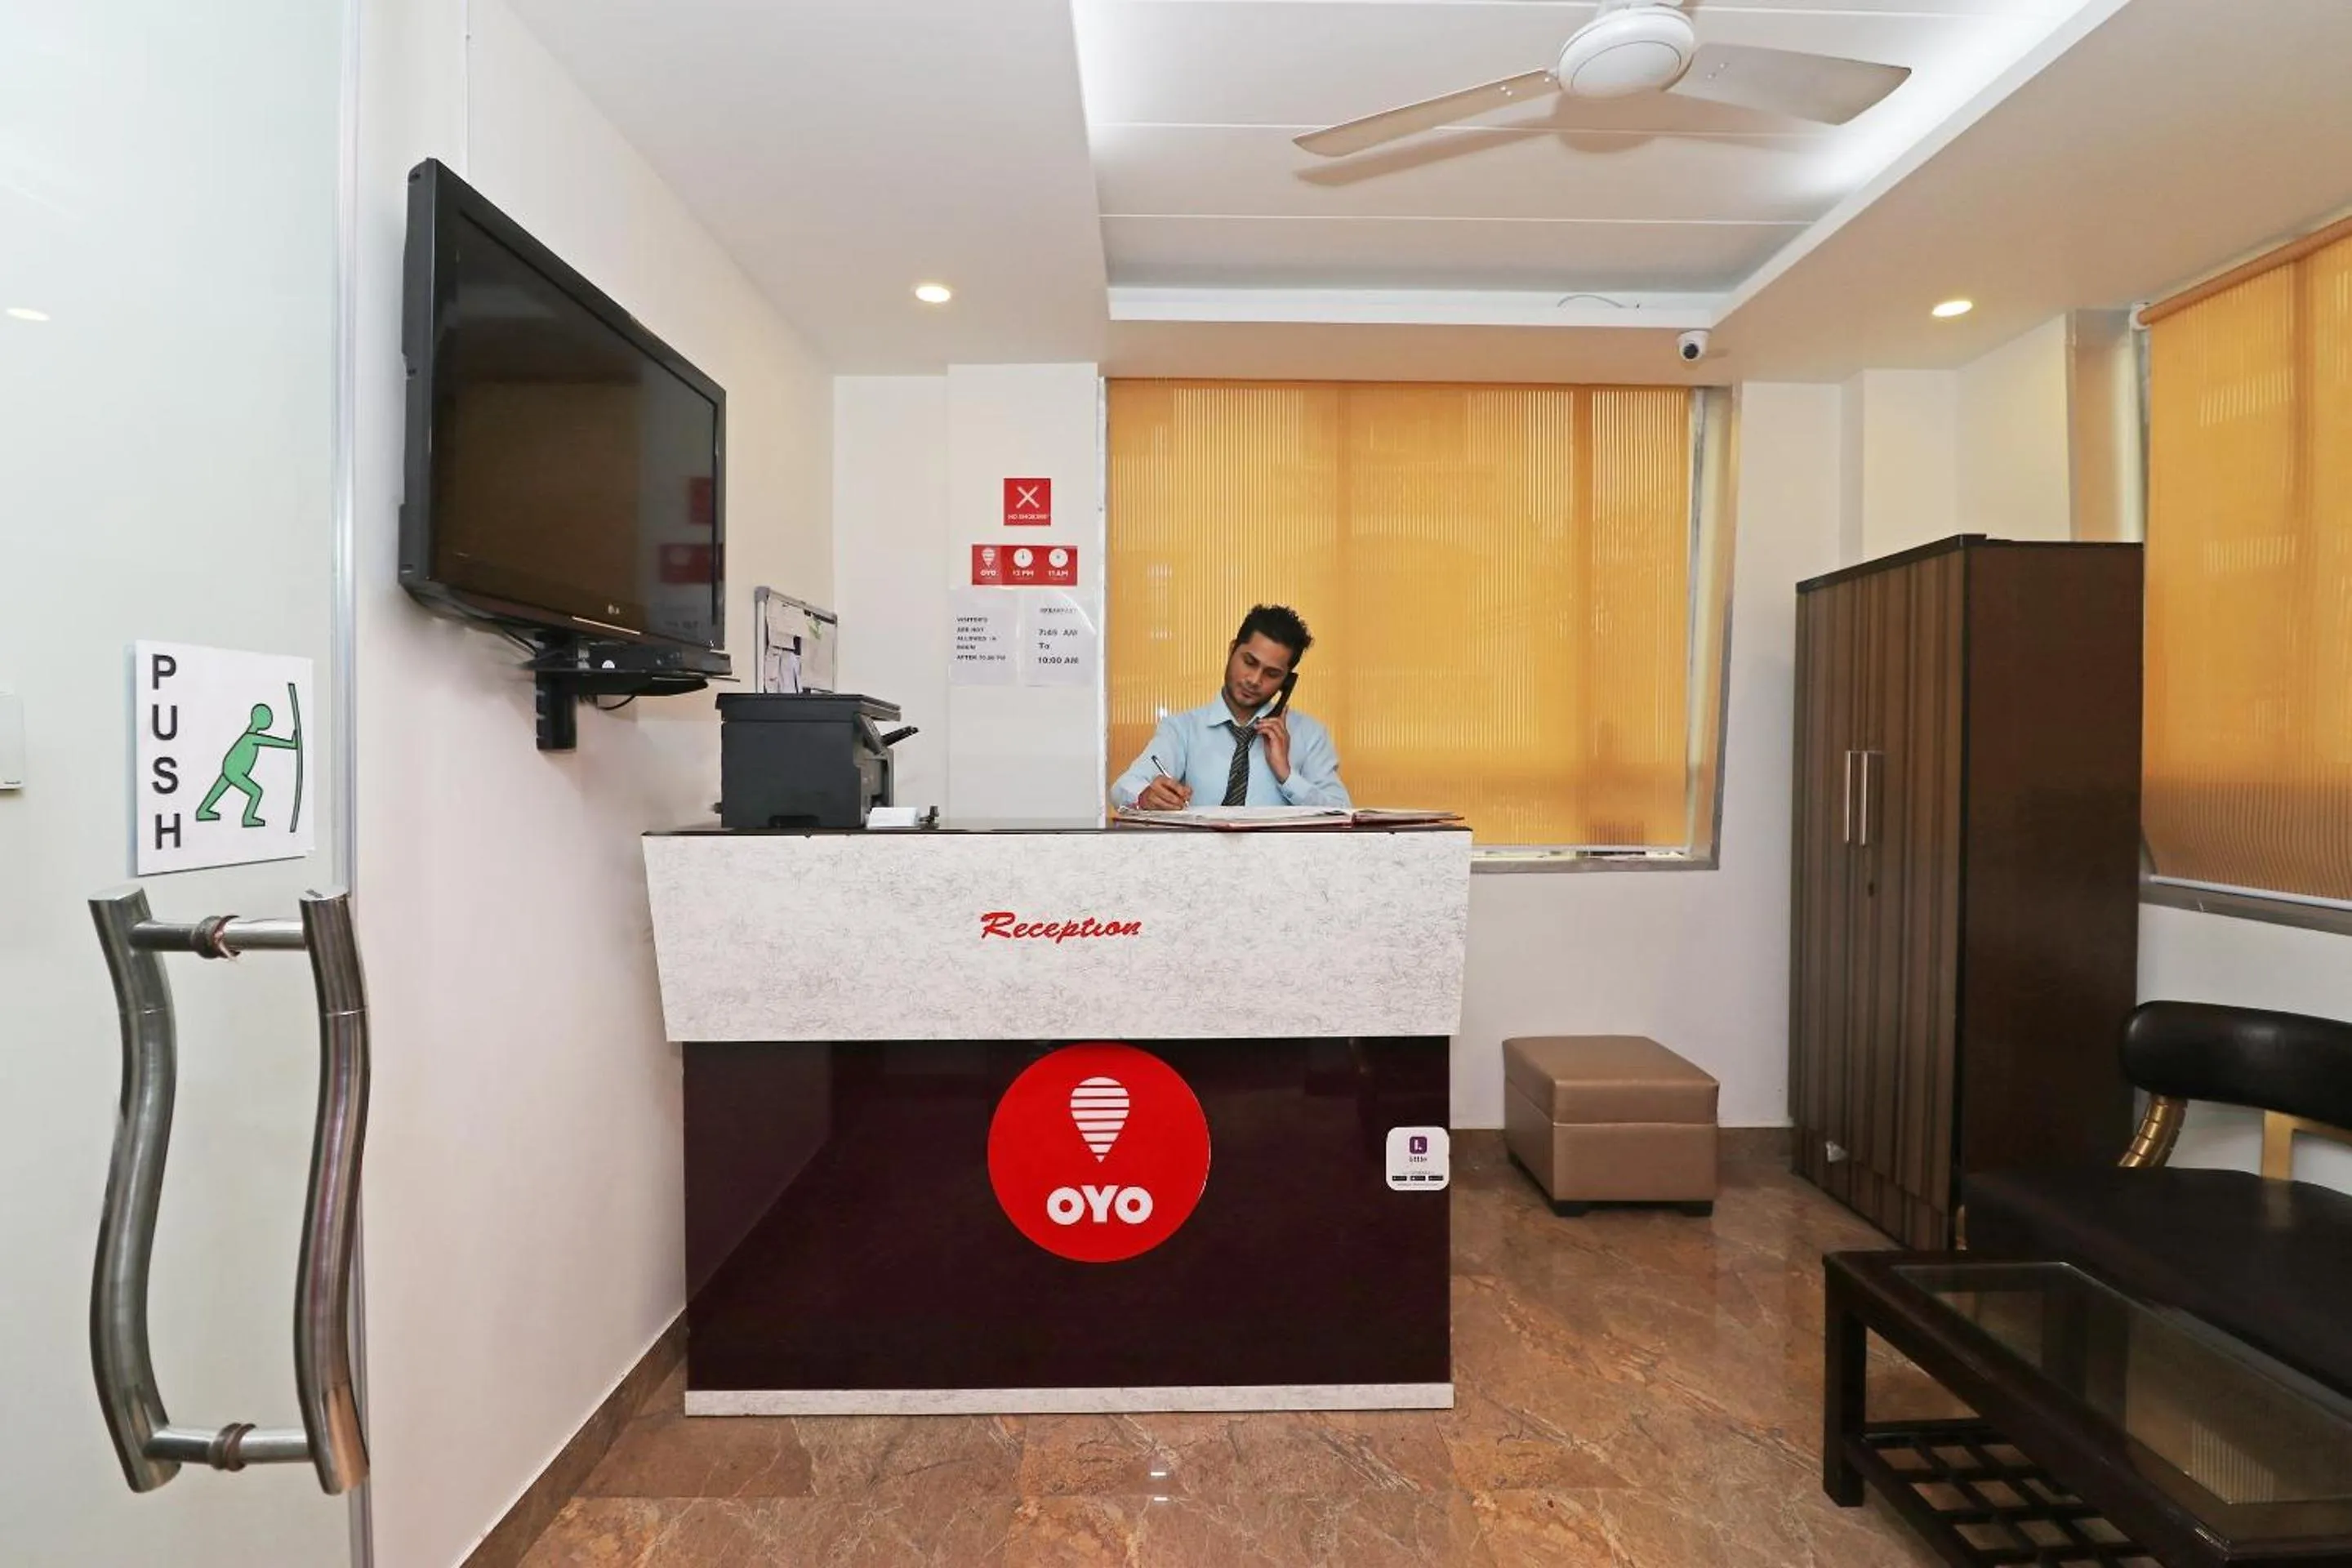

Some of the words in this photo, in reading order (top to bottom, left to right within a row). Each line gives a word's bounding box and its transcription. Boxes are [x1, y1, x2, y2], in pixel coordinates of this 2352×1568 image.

[1062, 628, 1078, 636] AM
[151, 653, 182, 850] PUSH
[980, 911, 1143, 944] Reception
[1046, 1184, 1154, 1226] OYO
